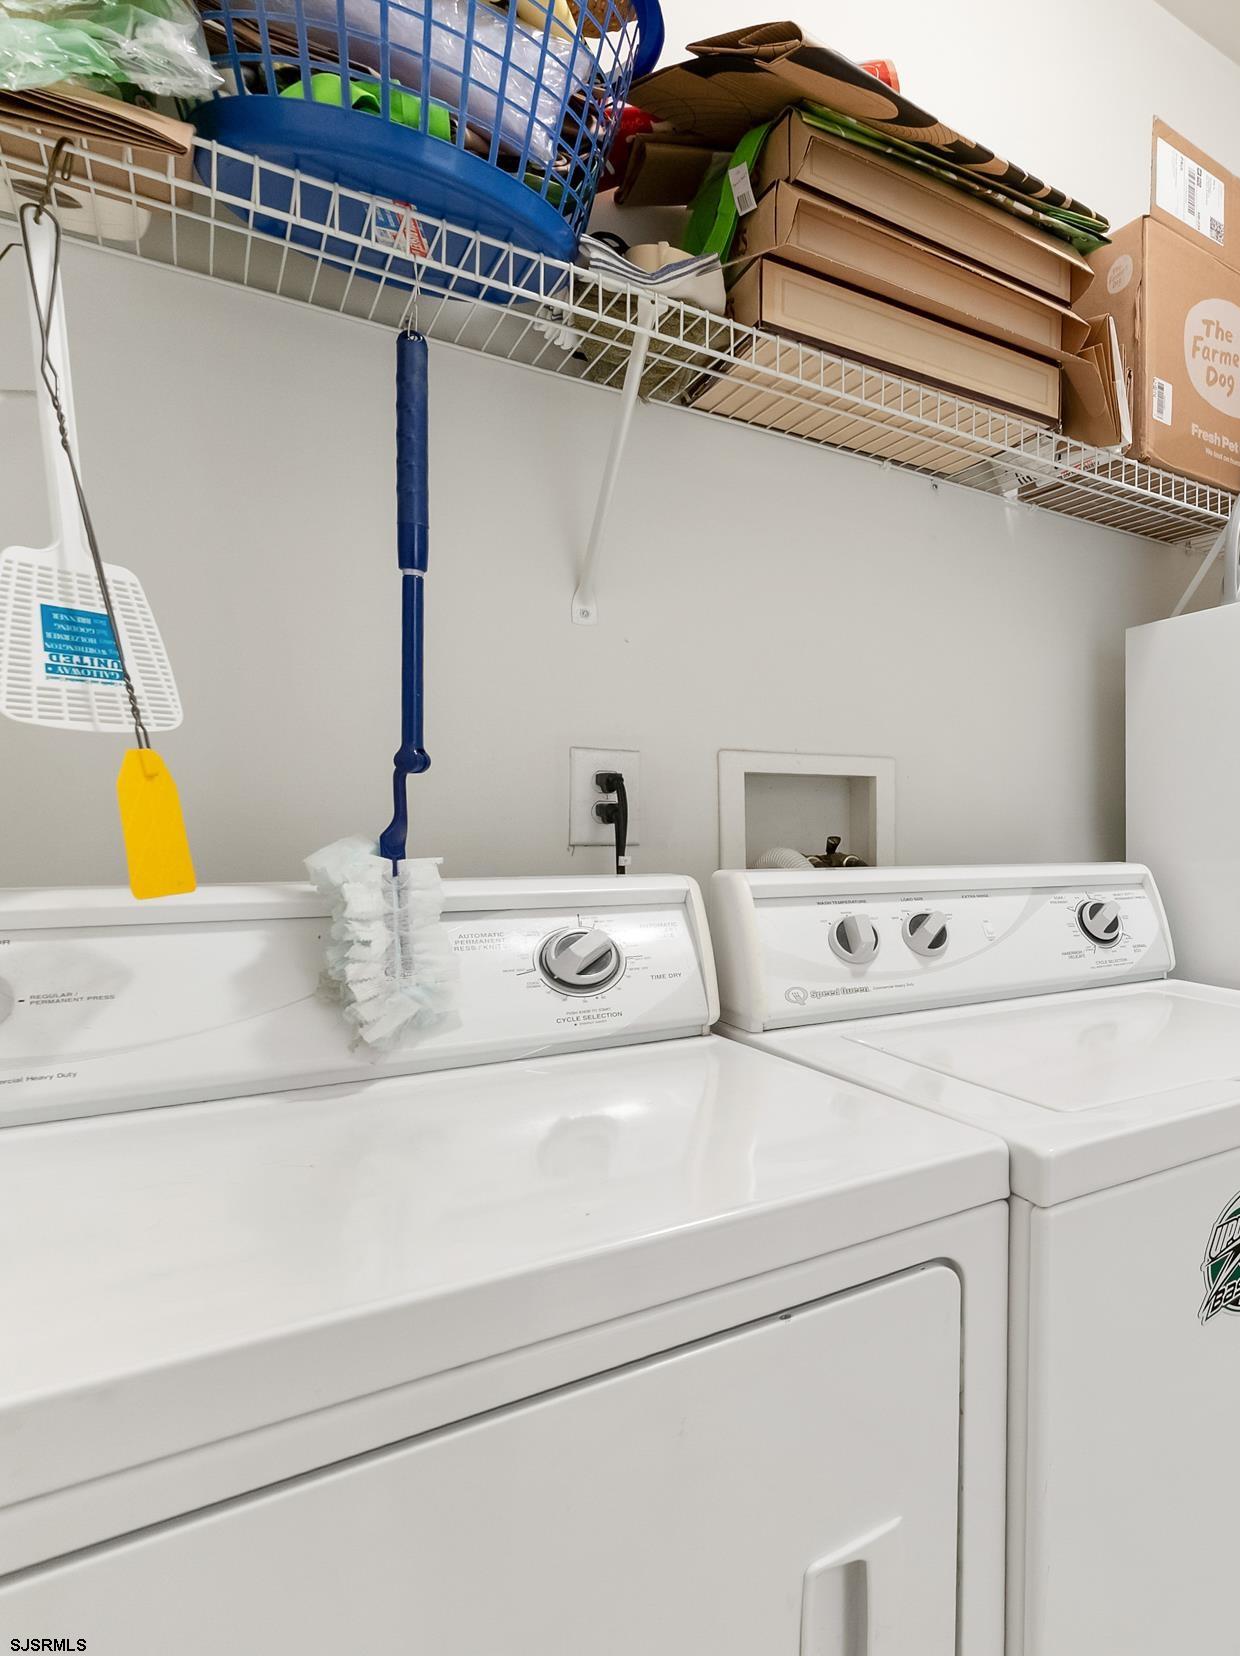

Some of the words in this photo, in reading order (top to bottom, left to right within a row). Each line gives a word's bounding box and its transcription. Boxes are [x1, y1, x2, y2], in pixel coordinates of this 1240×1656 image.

[1202, 318, 1233, 344] The
[1205, 366, 1236, 398] Dog
[1191, 423, 1221, 447] Fresh
[1221, 435, 1240, 453] Pet
[44, 642, 107, 655] WORTHINGTON
[48, 653, 122, 670] UNITED
[57, 666, 120, 680] GALLOWAY
[454, 937, 505, 945] PERMANENT
[650, 973, 667, 981] TIME
[29, 992, 73, 1000] REGULAR
[810, 987, 840, 1000] Speed
[29, 997, 84, 1005] PERMANENT
[556, 1015, 581, 1024] CYCLE
[582, 1011, 623, 1021] SELECTION
[0, 1076, 23, 1085] ercial
[26, 1073, 54, 1082] Heavy
[56, 1071, 78, 1080] Duty
